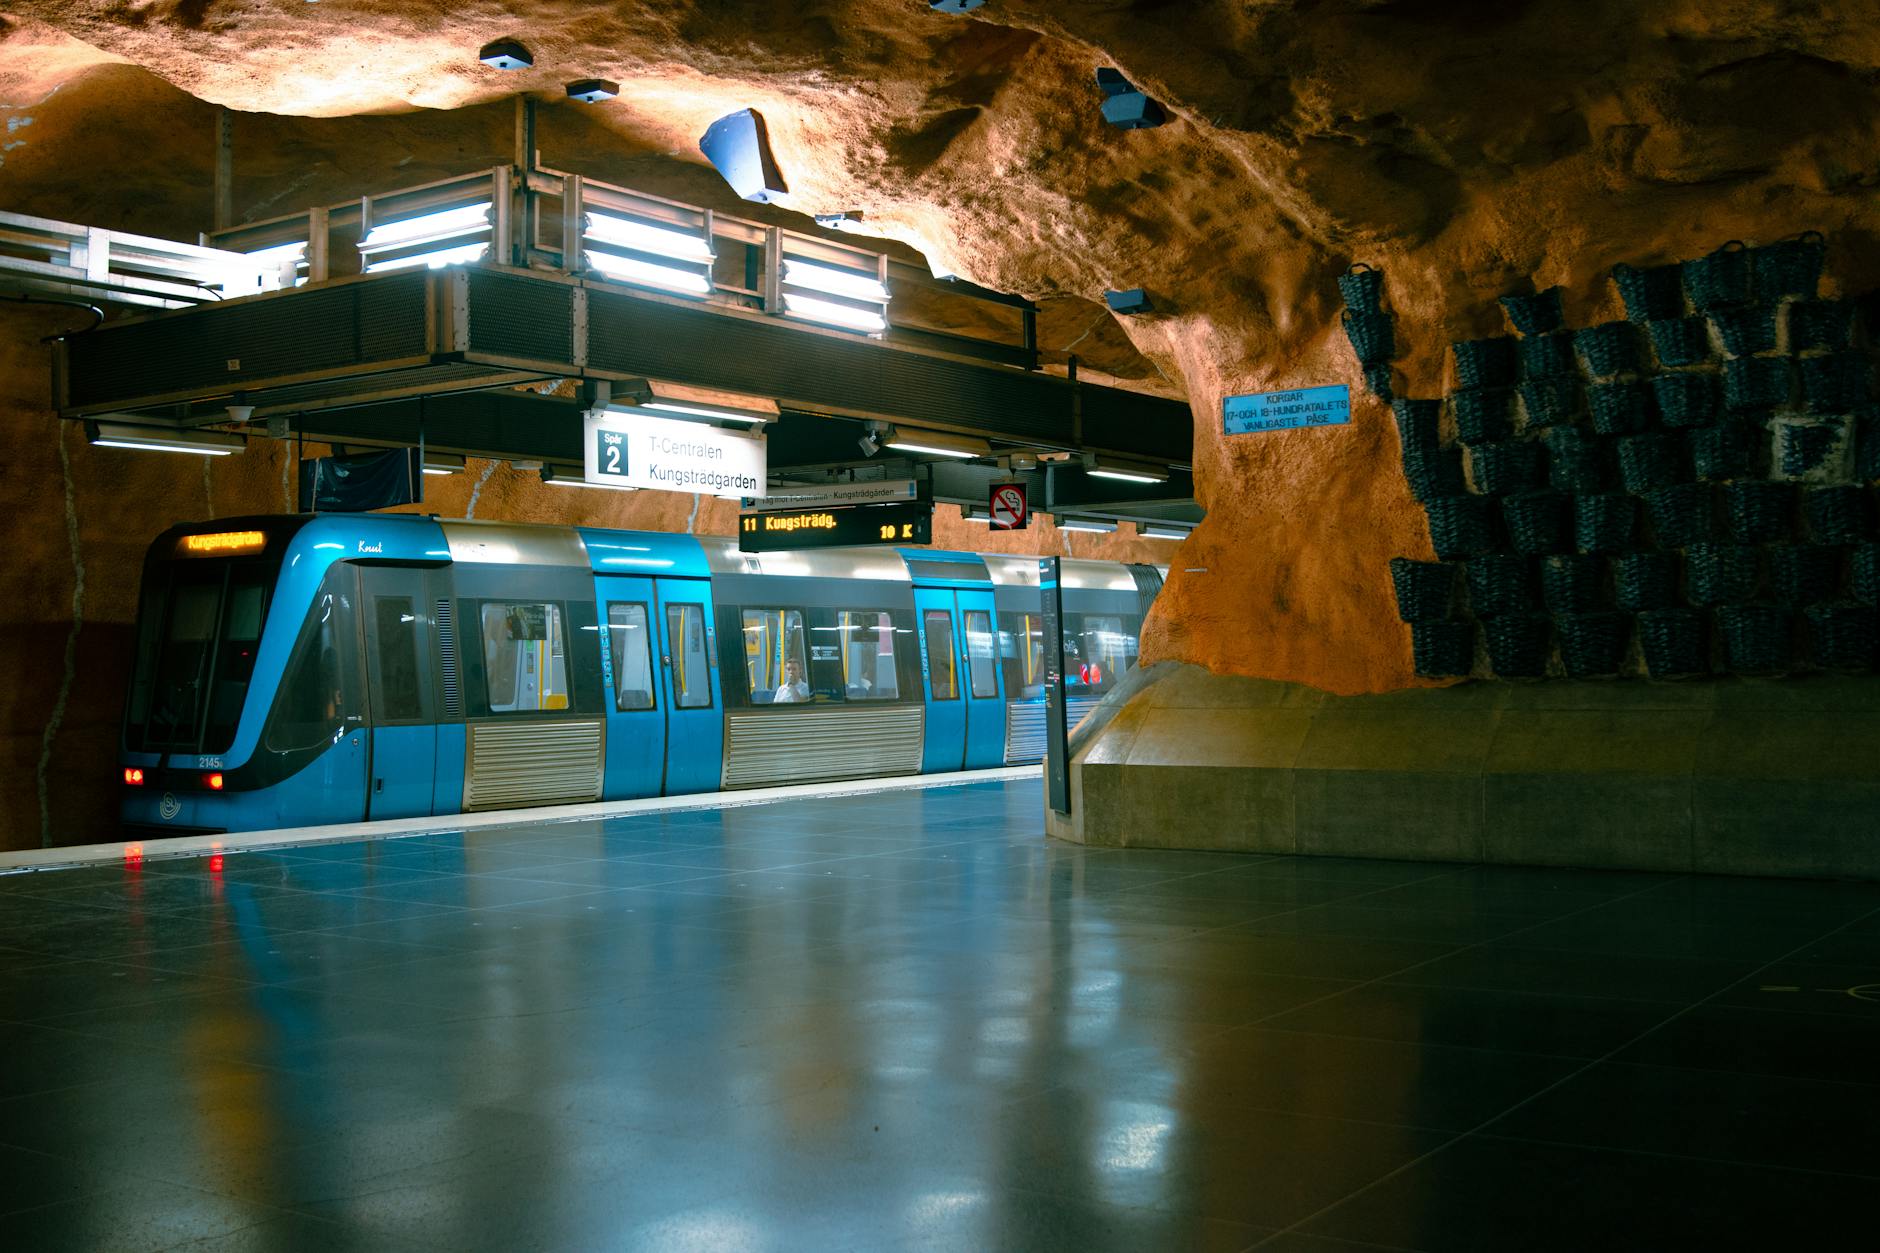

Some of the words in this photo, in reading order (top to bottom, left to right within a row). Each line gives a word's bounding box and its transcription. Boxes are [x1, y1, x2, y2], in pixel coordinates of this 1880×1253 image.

[1266, 392, 1304, 404] KORGAR
[1243, 418, 1298, 430] VANLIGASTE
[1306, 413, 1330, 425] PÅSE
[650, 436, 722, 460] T-Centralen
[606, 445, 621, 473] 2
[743, 518, 757, 532] 11
[765, 513, 837, 531] Kungsträdg.
[880, 525, 896, 539] 10
[902, 524, 912, 538] K
[357, 540, 383, 554] Knut
